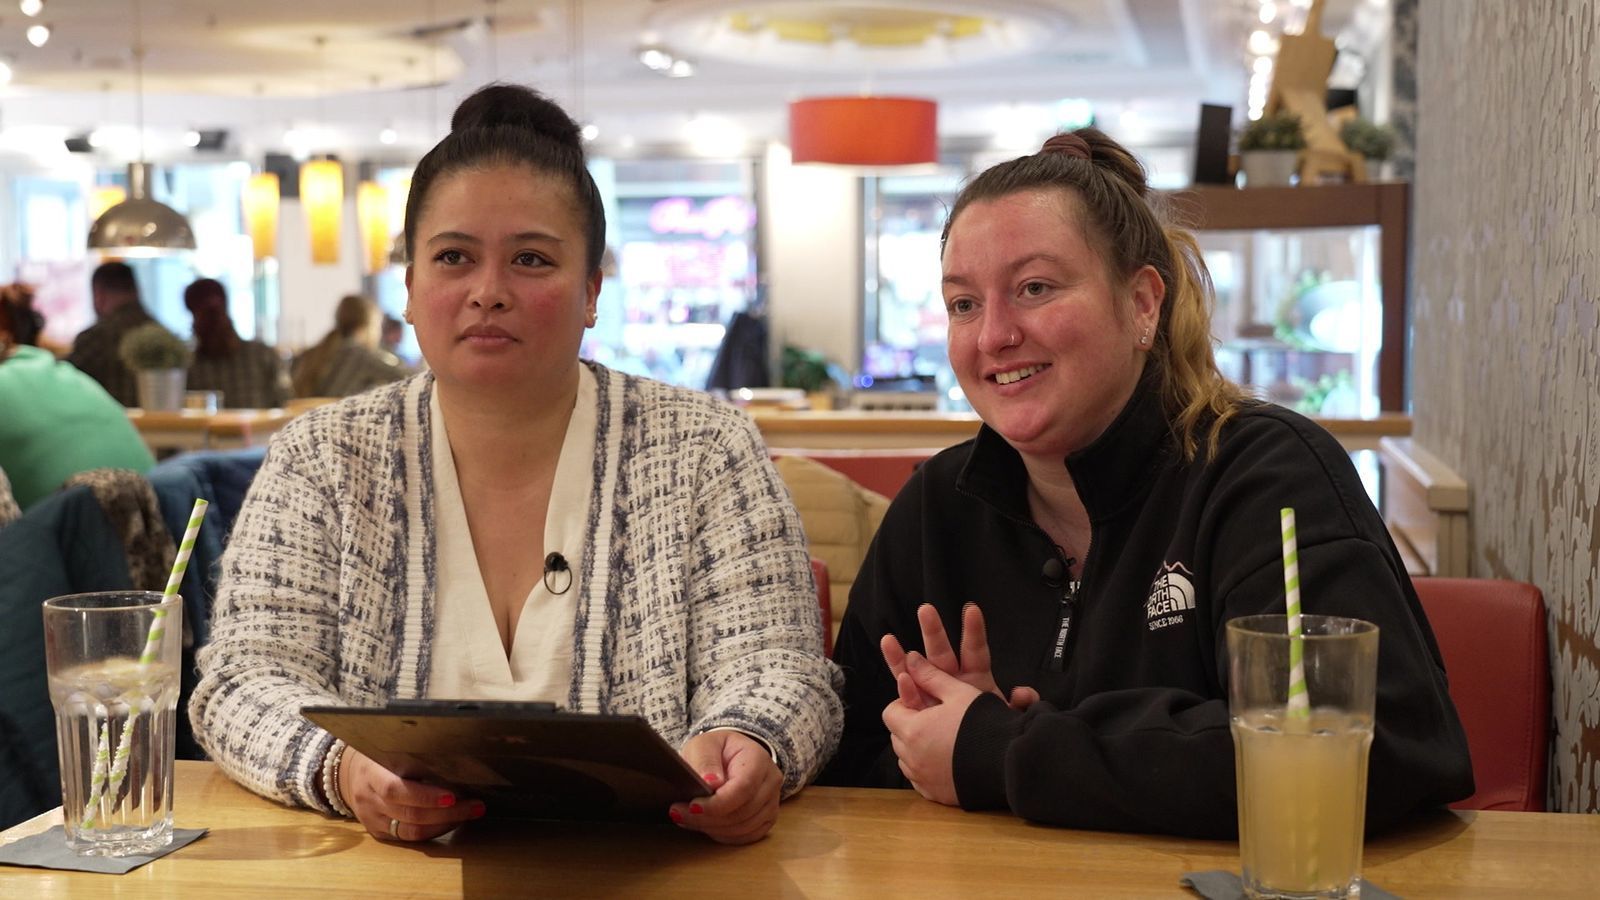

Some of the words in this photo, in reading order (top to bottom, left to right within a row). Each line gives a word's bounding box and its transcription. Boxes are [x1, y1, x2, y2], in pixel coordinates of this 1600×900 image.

[1153, 574, 1169, 592] THE
[1146, 587, 1170, 608] RTH
[1147, 600, 1171, 619] FACE
[1061, 617, 1070, 629] THE
[1148, 617, 1168, 631] SINCE
[1167, 614, 1184, 626] 1966
[1054, 646, 1064, 658] FACE
